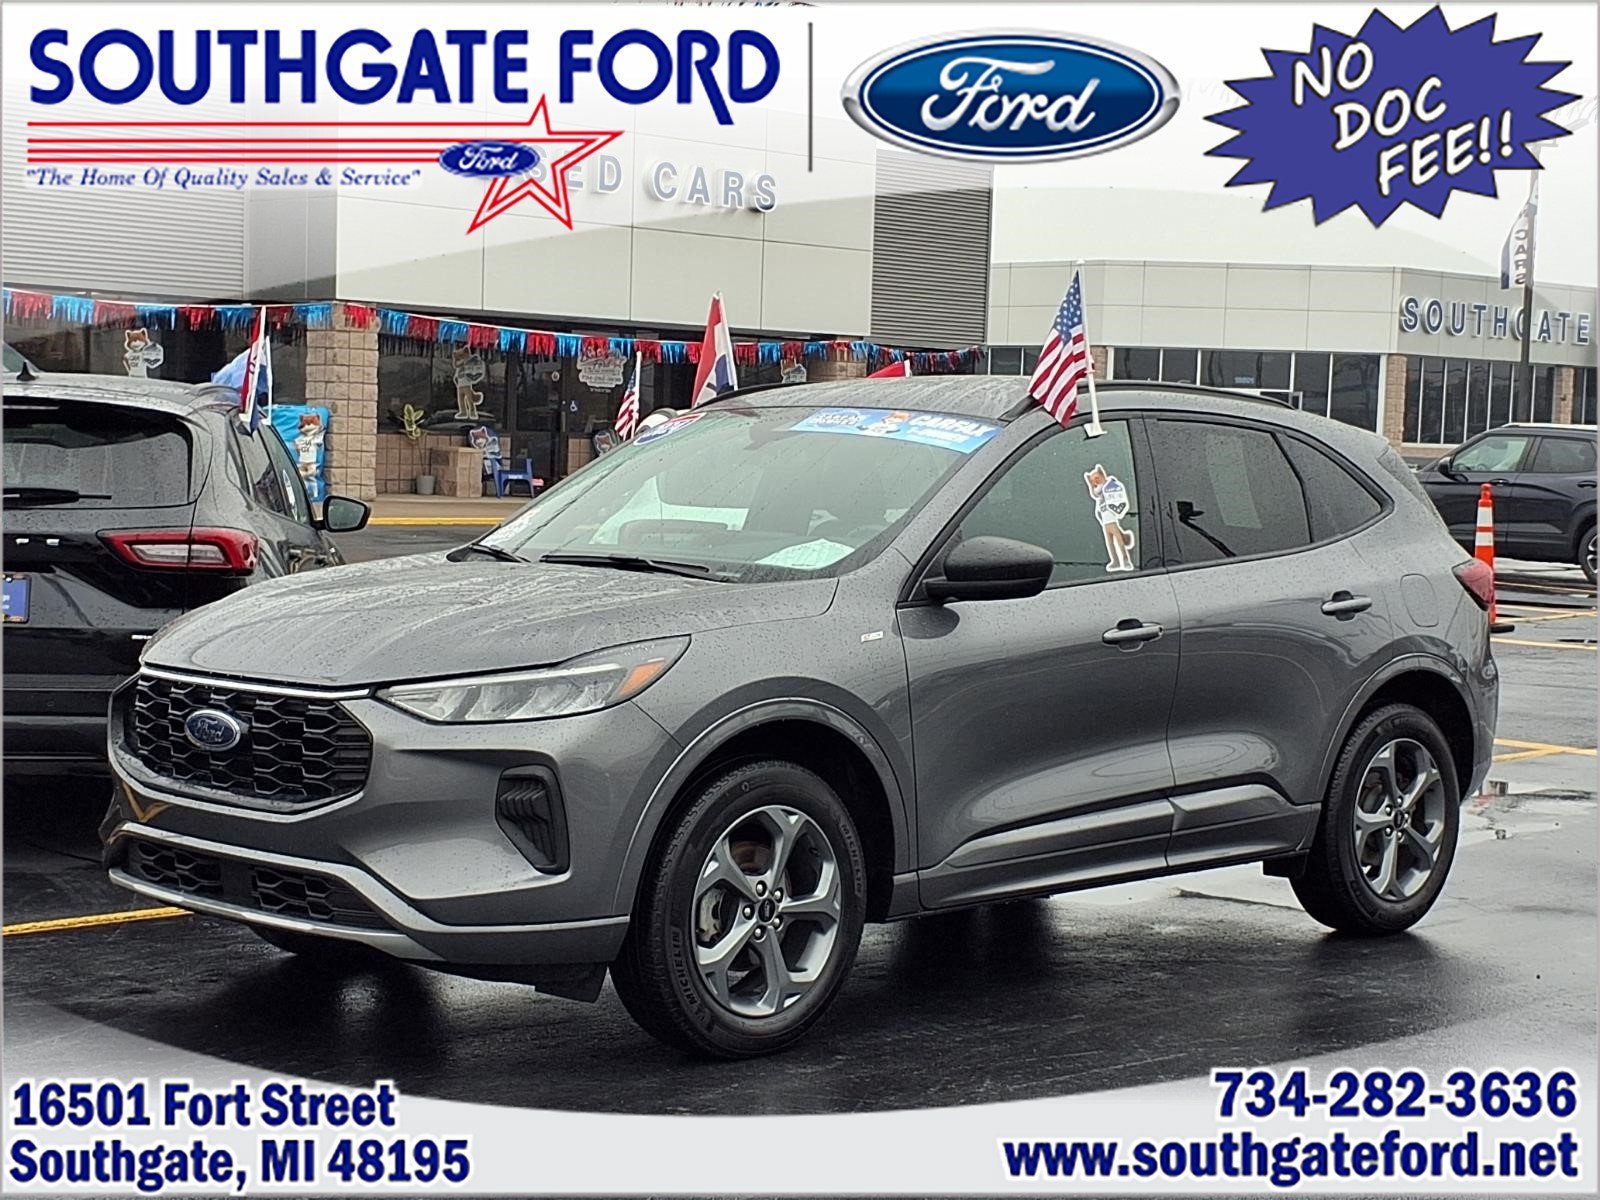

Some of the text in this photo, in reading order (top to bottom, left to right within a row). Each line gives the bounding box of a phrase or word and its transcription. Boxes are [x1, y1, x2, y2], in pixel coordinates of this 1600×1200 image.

[521, 145, 778, 212] SED CARS
[909, 414, 996, 437] CARFAX
